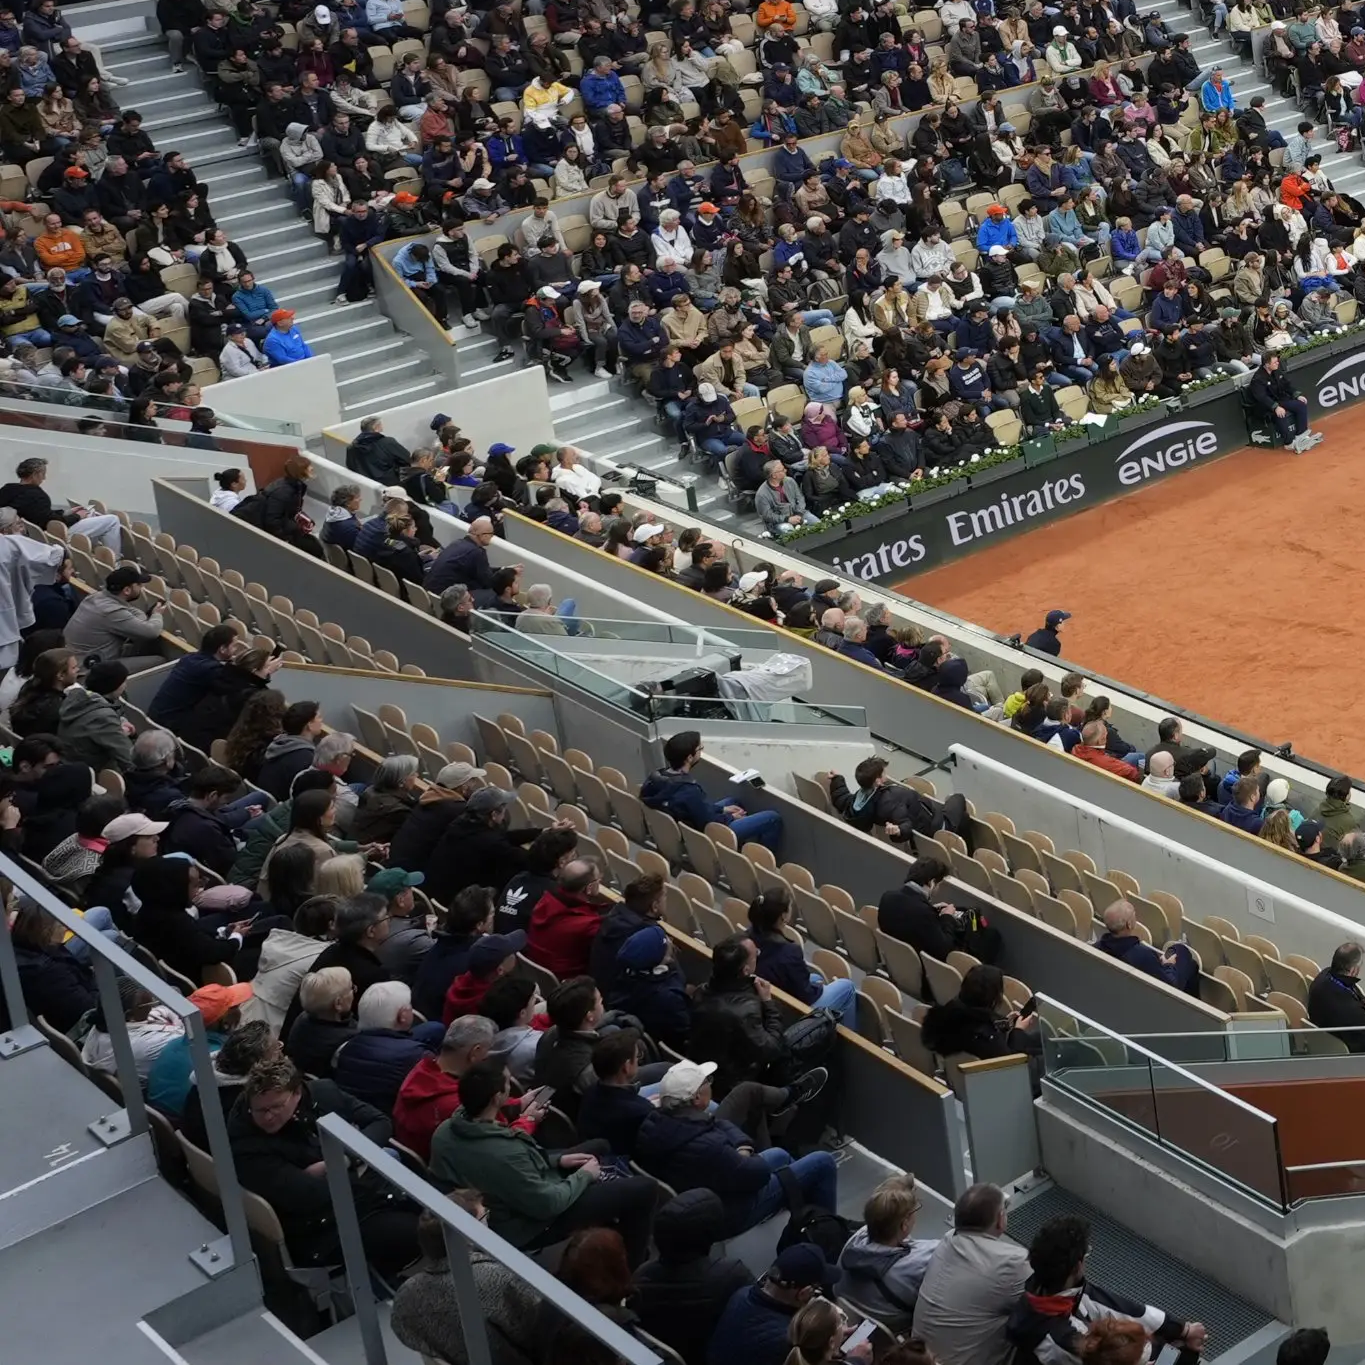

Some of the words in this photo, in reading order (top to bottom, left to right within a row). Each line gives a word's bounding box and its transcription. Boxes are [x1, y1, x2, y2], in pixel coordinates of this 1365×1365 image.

[945, 473, 1086, 546] Emirates
[832, 533, 927, 581] irates
[43, 1142, 79, 1167] 14
